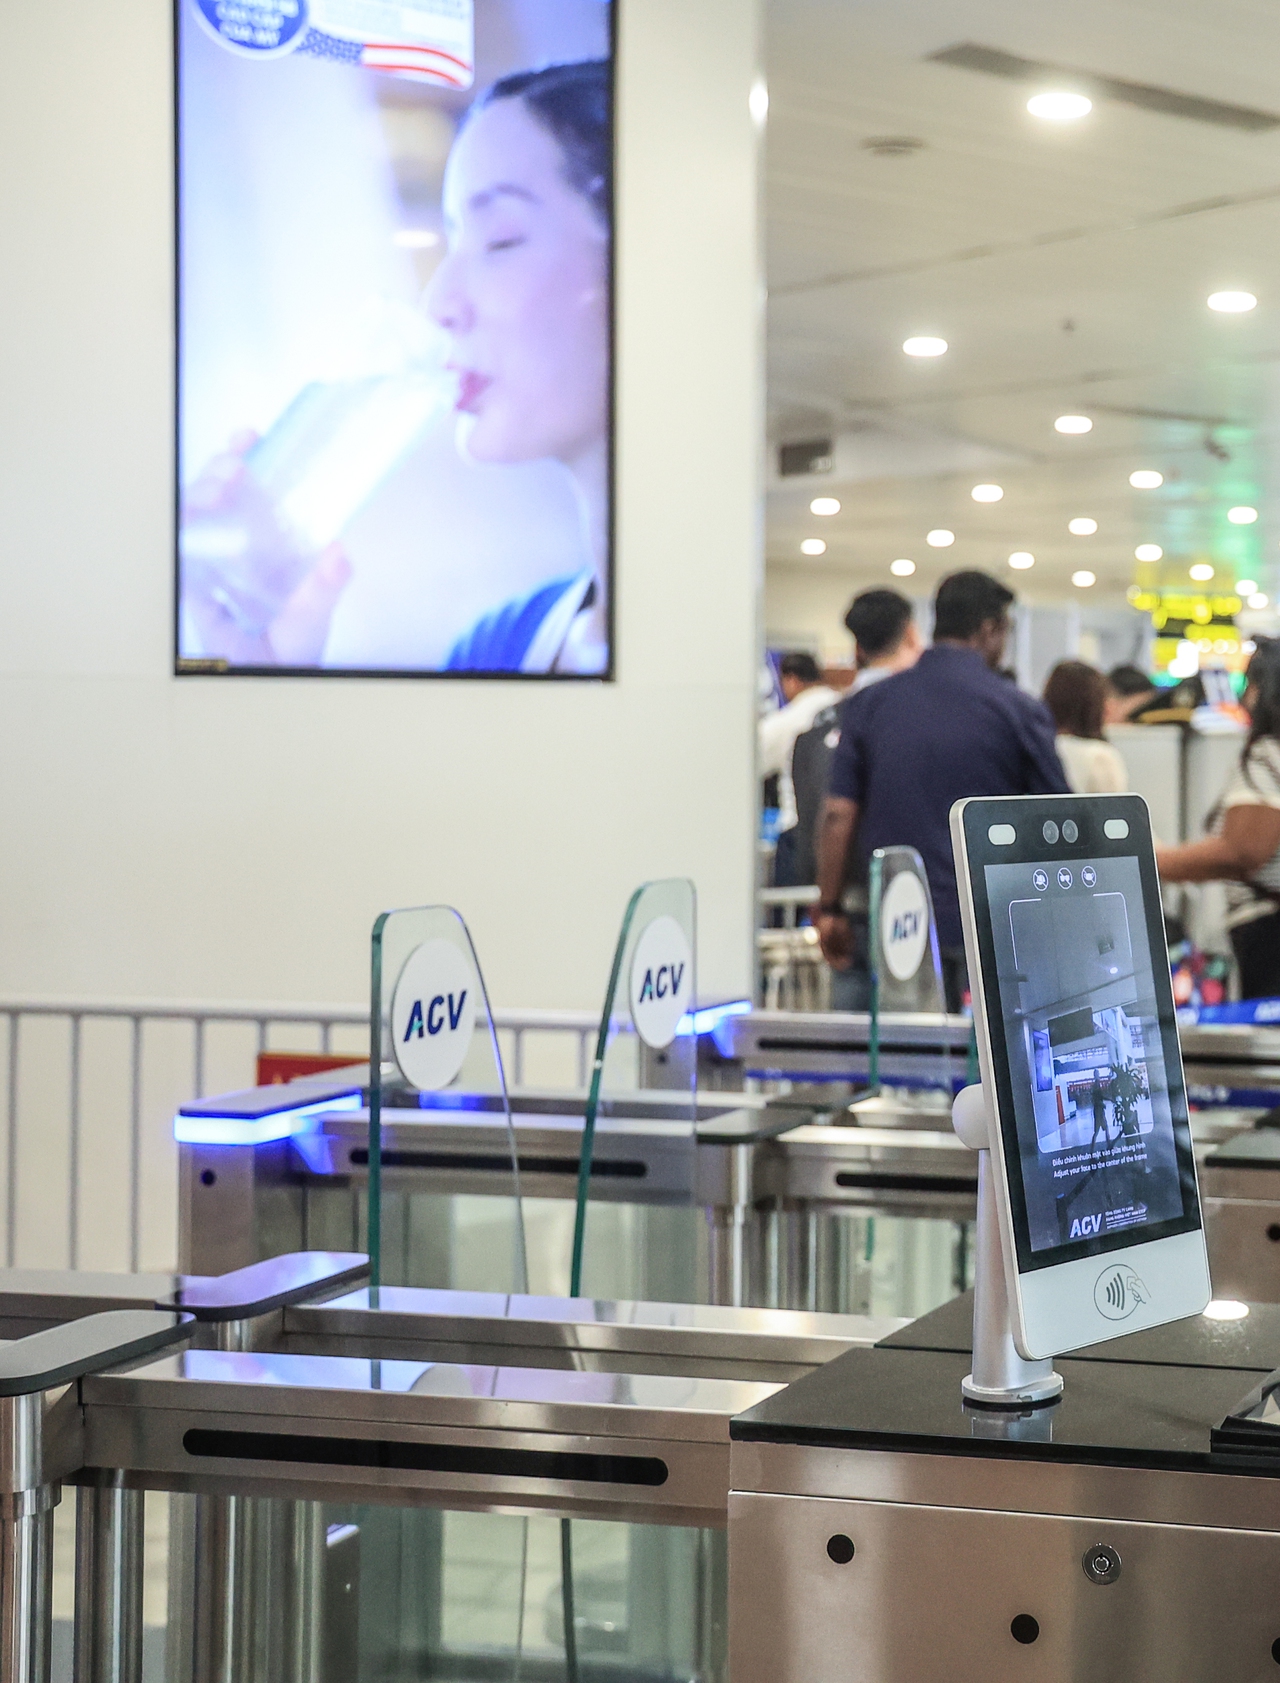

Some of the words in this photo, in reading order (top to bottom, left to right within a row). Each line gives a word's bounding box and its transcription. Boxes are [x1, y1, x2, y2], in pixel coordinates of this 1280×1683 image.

[889, 911, 922, 944] ACV
[639, 963, 685, 1003] ACV
[403, 990, 468, 1043] ACV
[1053, 1168, 1069, 1179] Adjust
[1069, 1167, 1081, 1176] your
[1080, 1164, 1091, 1173] face
[1097, 1161, 1105, 1169] the
[1105, 1158, 1120, 1168] center
[1120, 1156, 1126, 1164] of
[1126, 1155, 1134, 1163] the
[1134, 1153, 1147, 1161] frame
[1069, 1213, 1102, 1239] ACV
